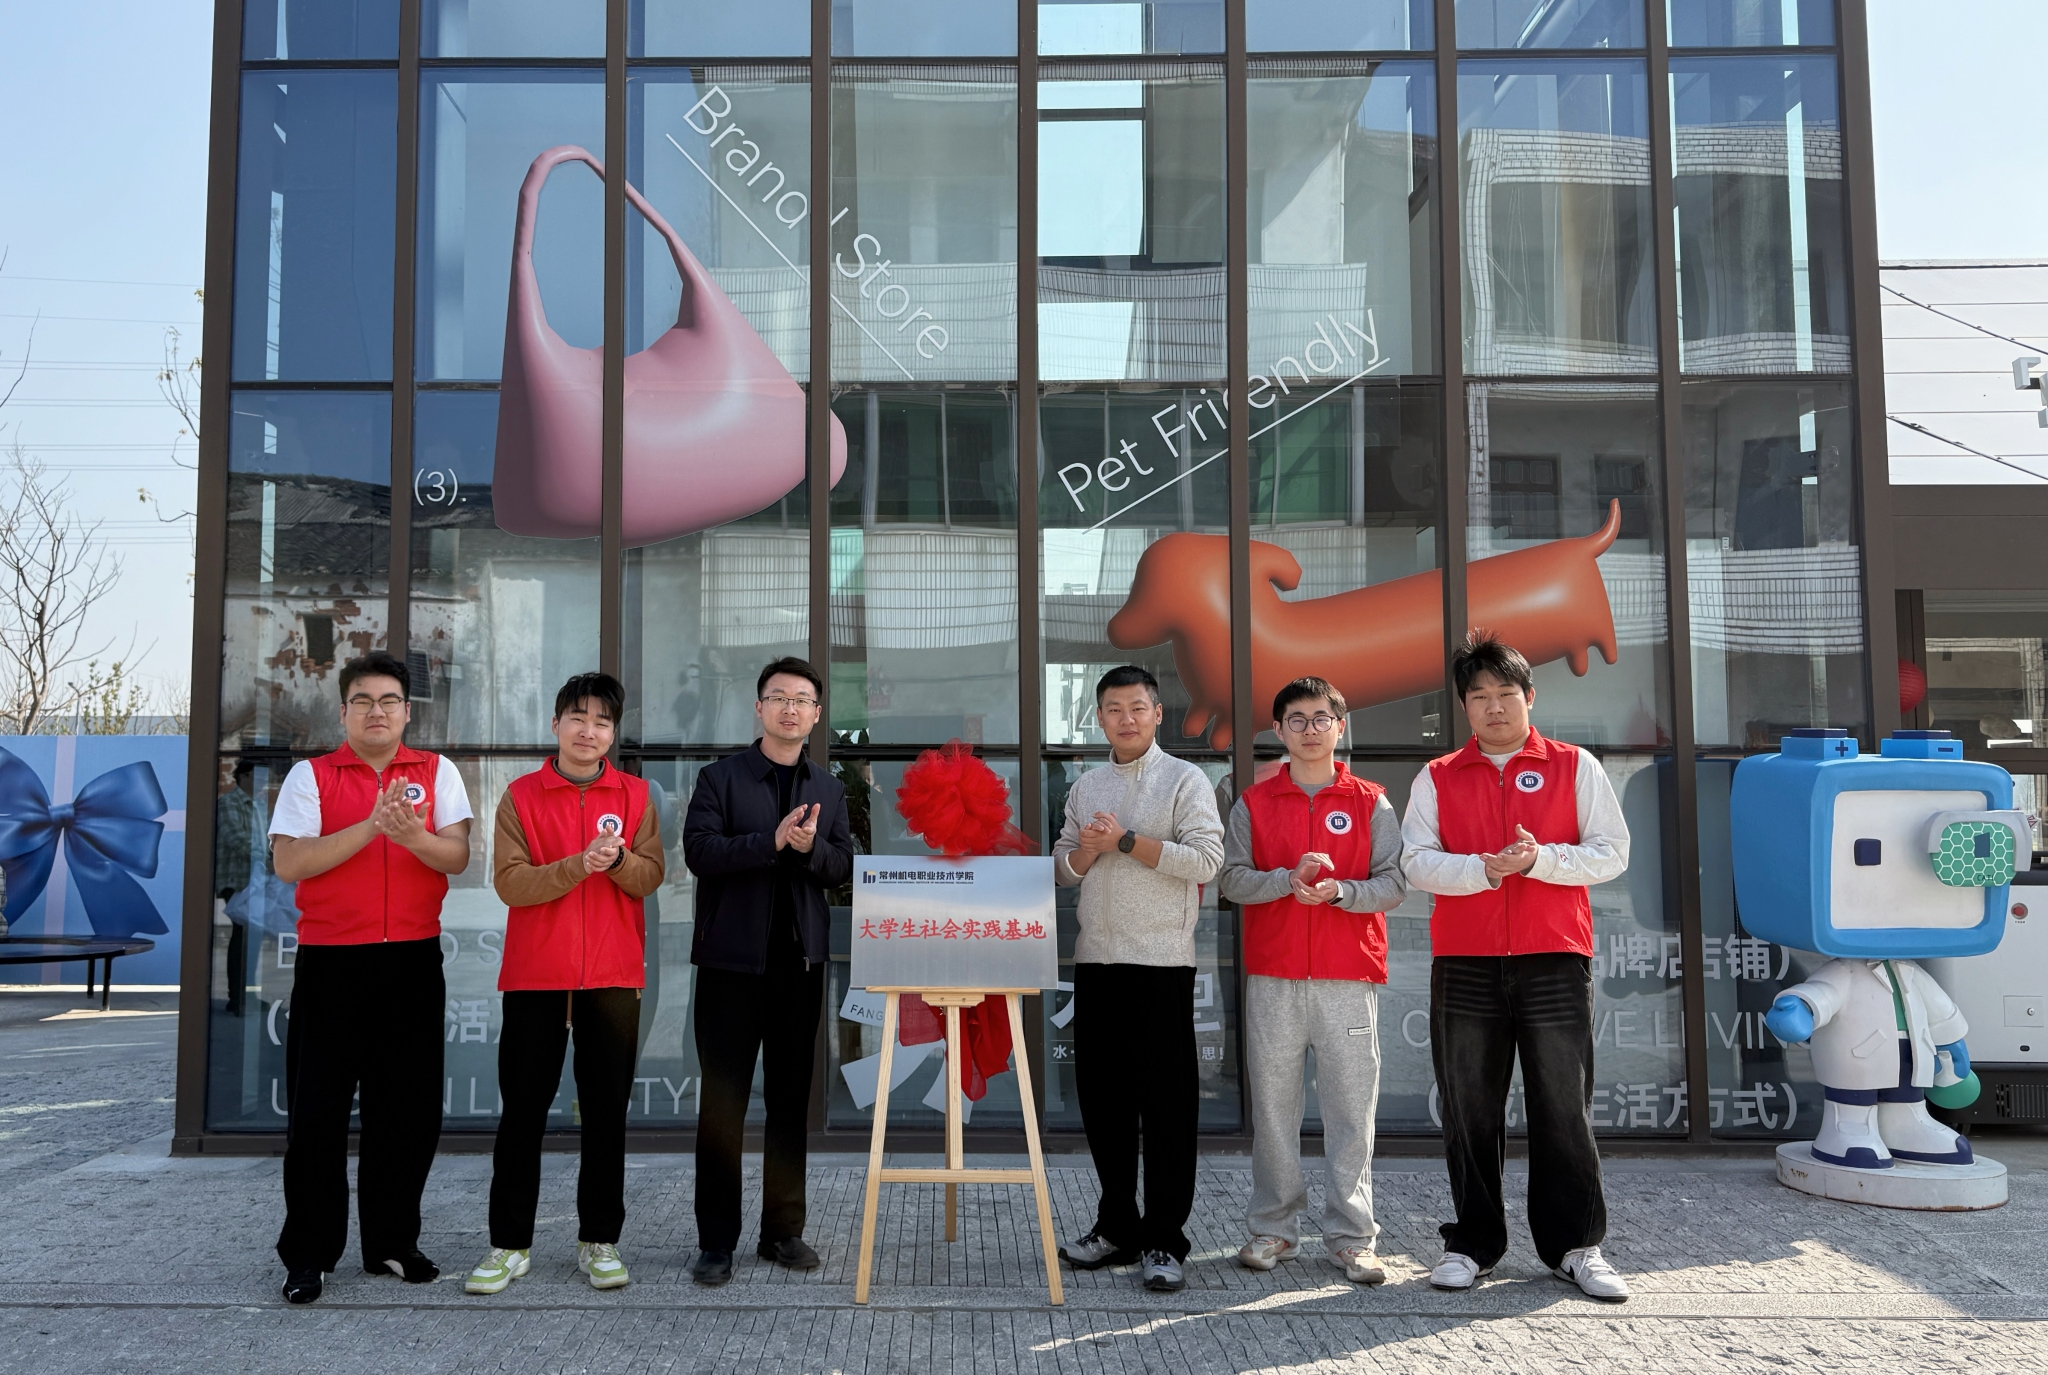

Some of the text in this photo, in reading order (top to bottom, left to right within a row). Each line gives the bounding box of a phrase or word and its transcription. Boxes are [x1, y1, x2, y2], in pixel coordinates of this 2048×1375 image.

[683, 85, 949, 359] Brand Store
[1057, 308, 1379, 512] Pet Friendly
[414, 468, 467, 506] (3).
[879, 870, 974, 881] 常州机电职业技术学院
[859, 917, 1047, 941] 大学生社会实践基地
